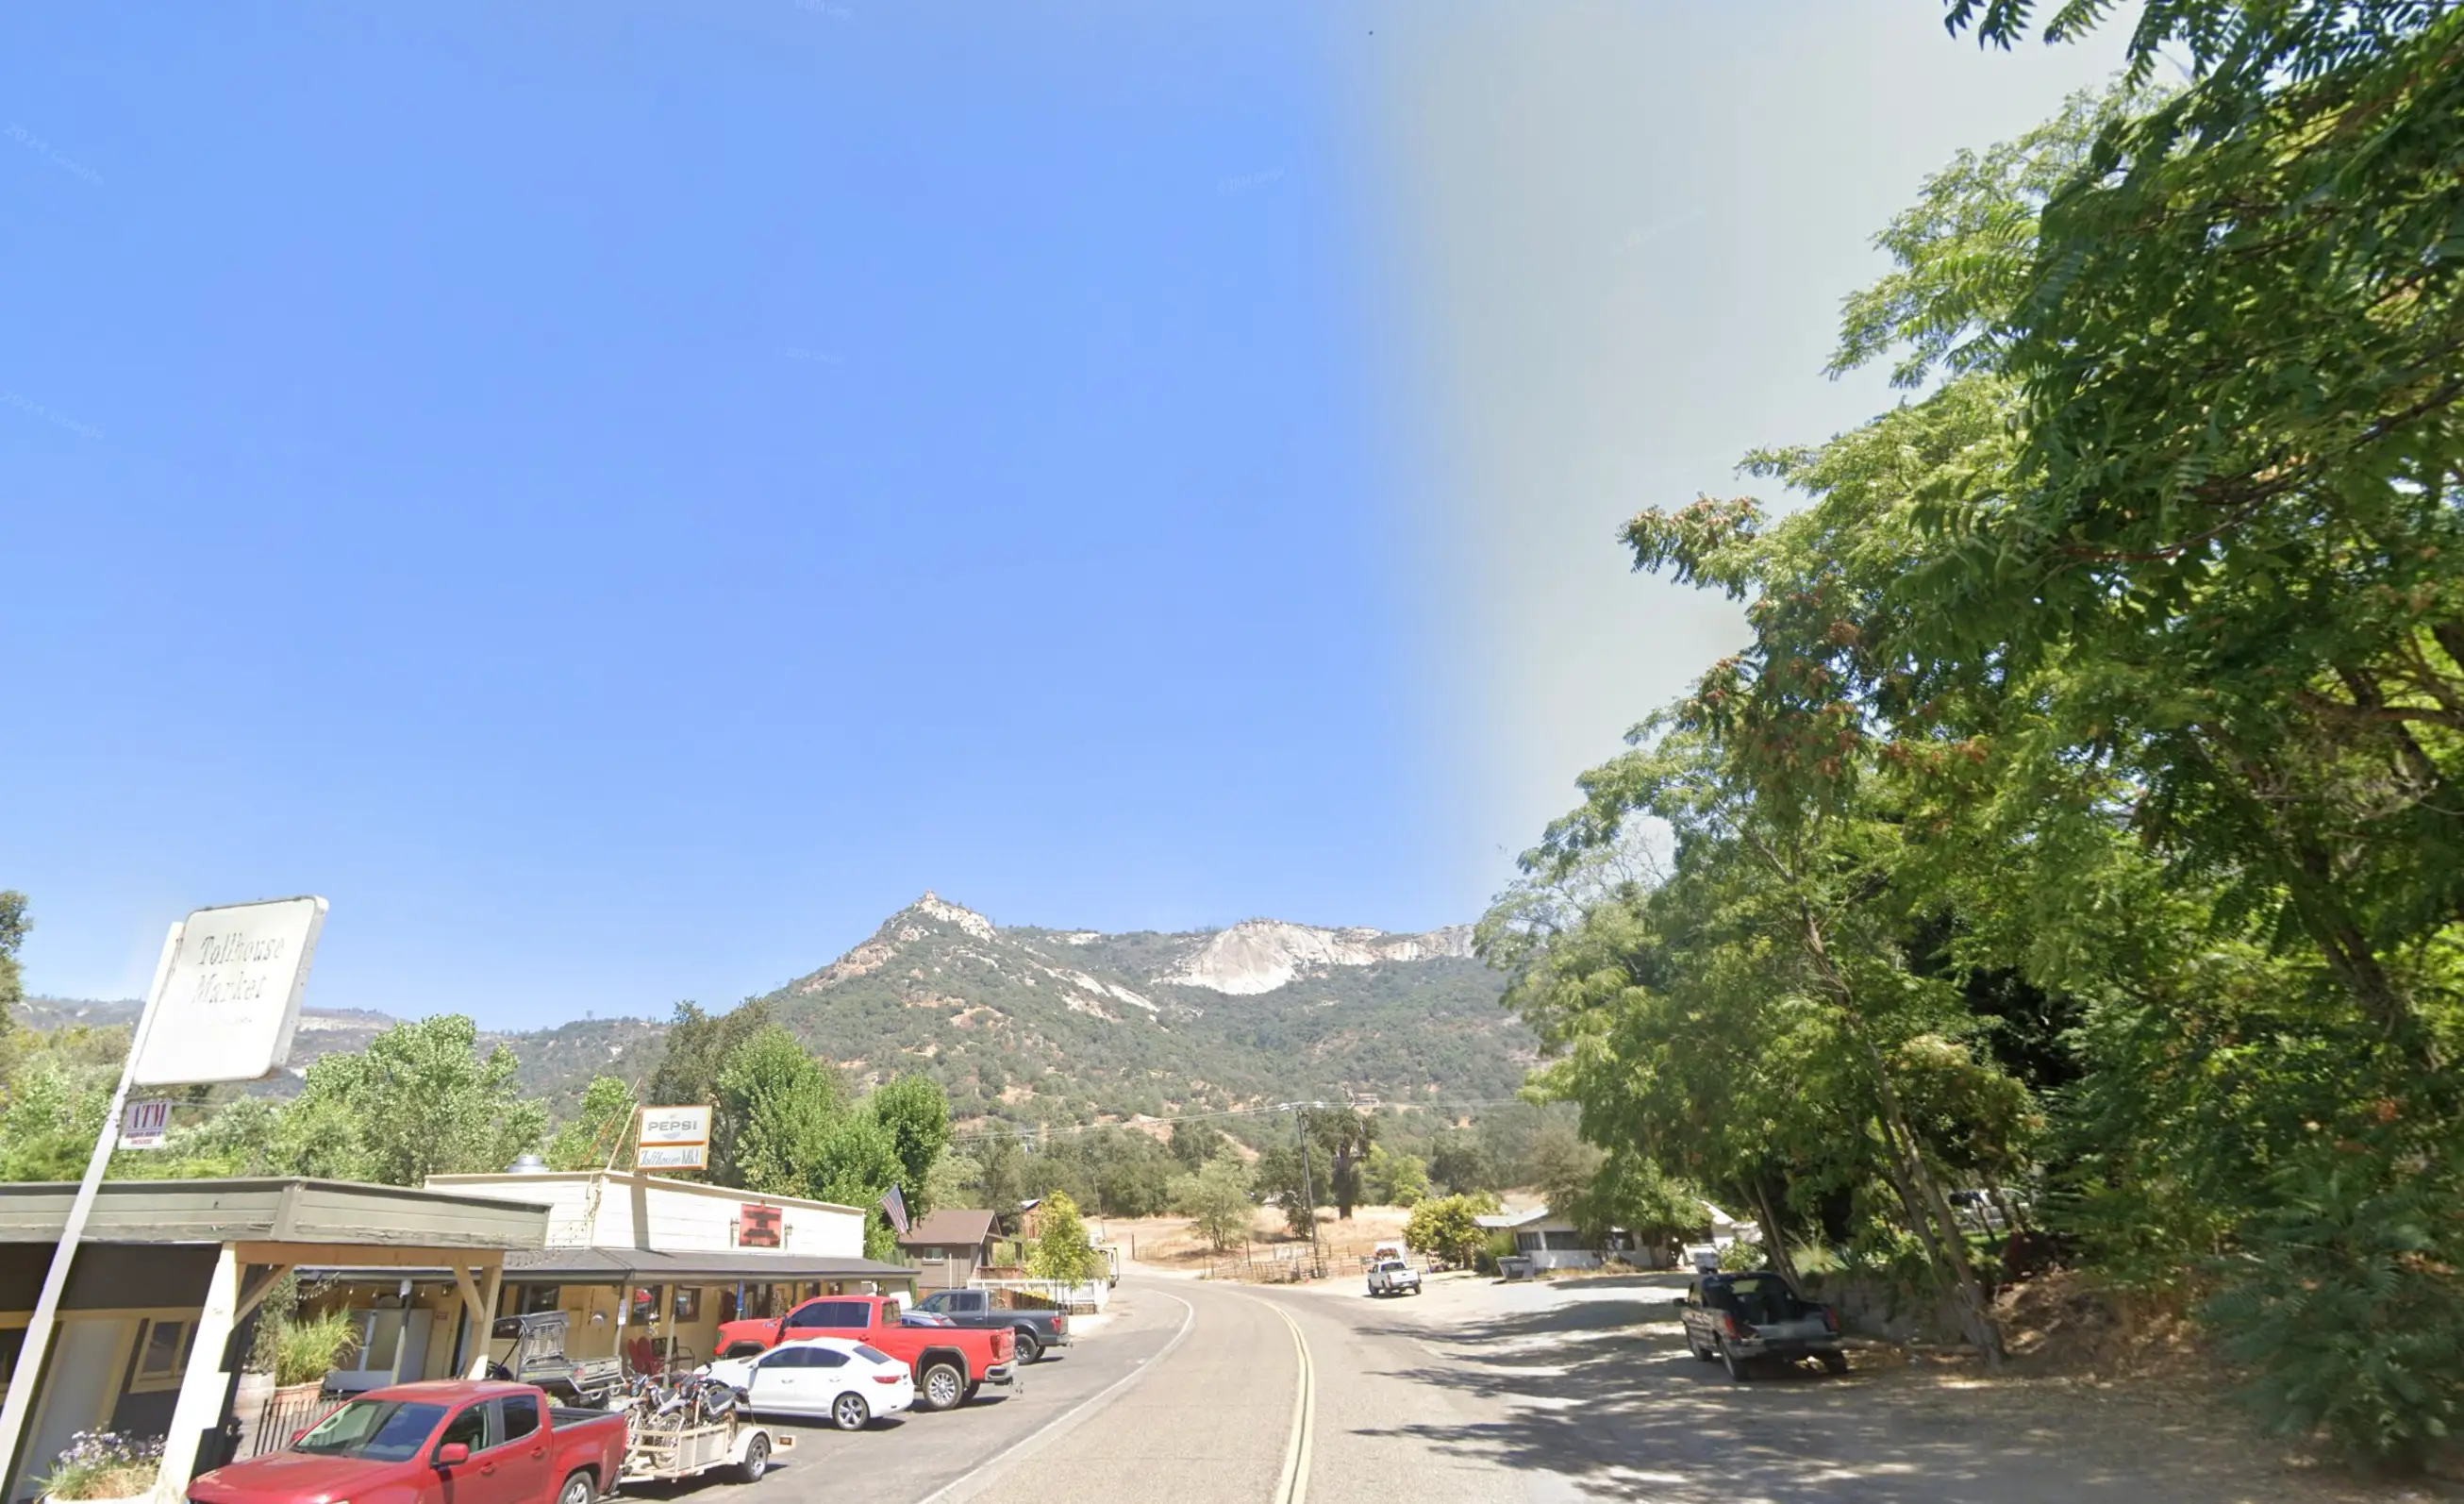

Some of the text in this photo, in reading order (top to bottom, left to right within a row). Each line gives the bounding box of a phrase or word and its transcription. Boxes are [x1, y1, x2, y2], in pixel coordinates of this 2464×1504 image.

[197, 932, 285, 965] Tollhouse
[191, 971, 268, 1005] Market
[647, 1120, 698, 1131] PEPSI
